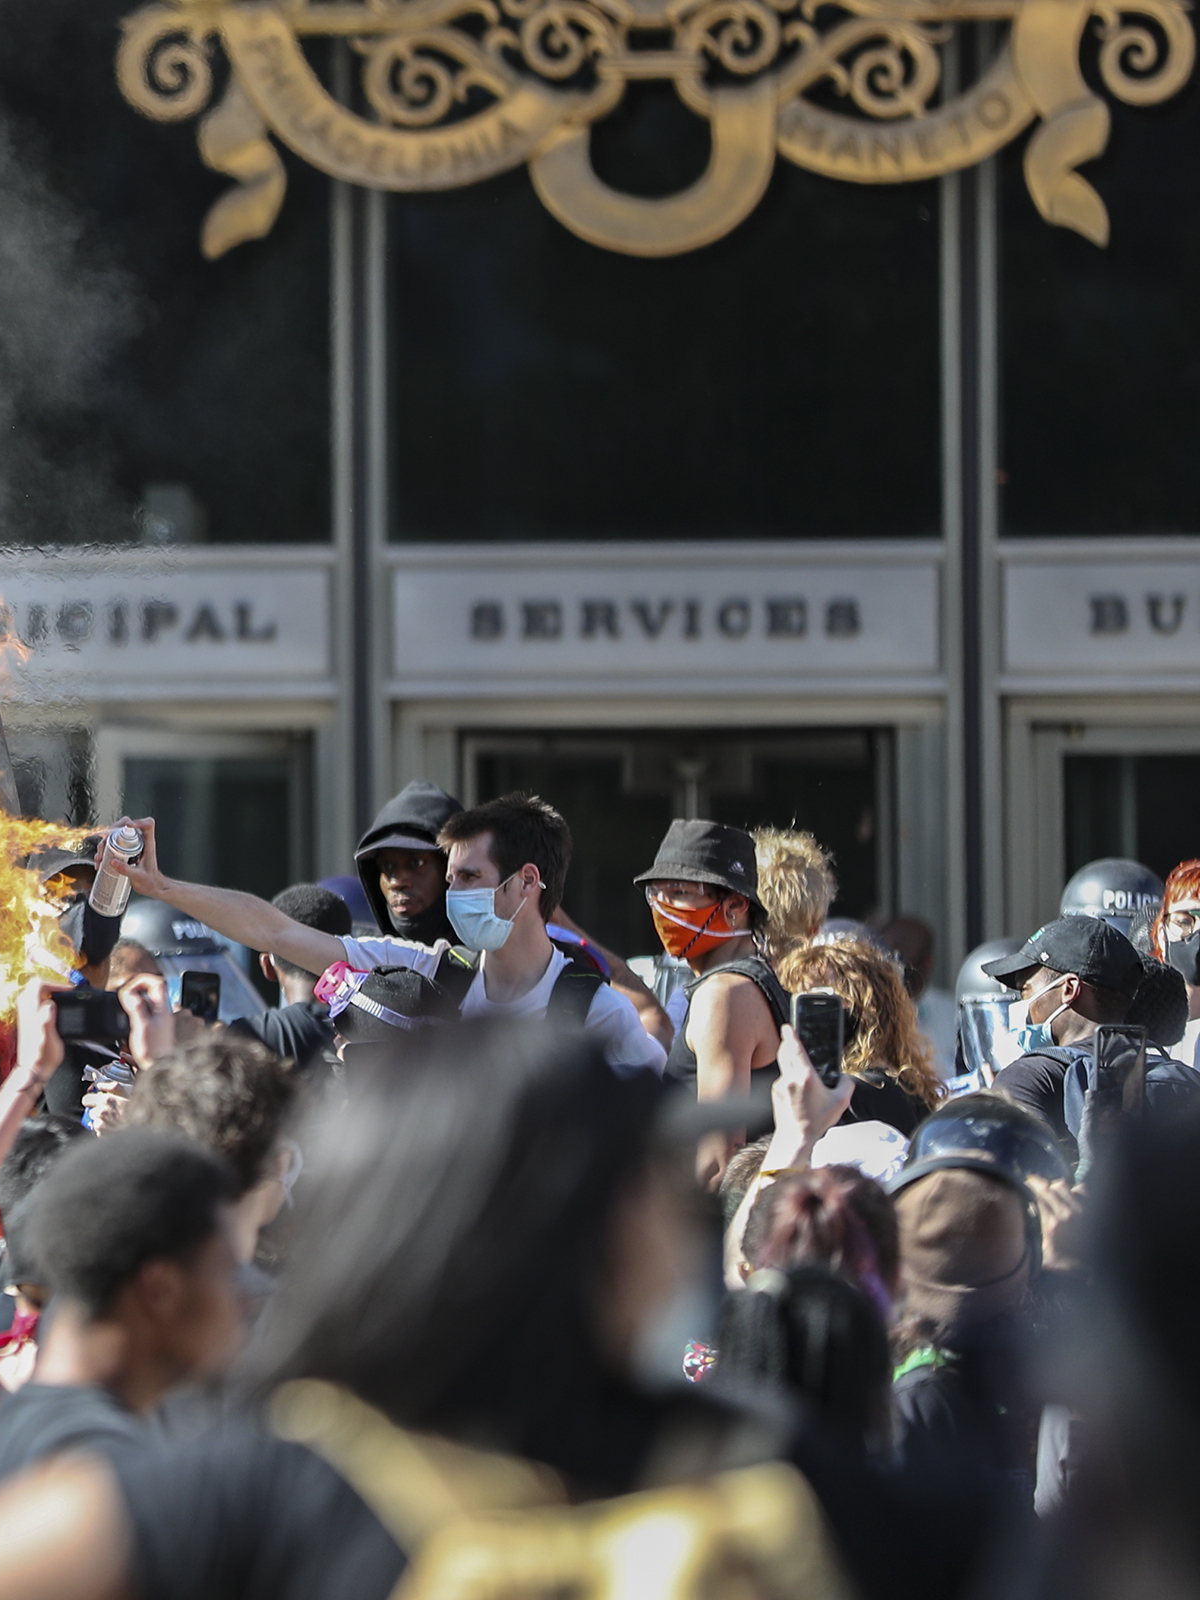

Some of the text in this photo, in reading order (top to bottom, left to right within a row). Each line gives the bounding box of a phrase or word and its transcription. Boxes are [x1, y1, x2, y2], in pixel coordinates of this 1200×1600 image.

[779, 89, 1014, 168] MANETO
[471, 595, 862, 642] SERVICES
[1088, 592, 1188, 638] BU
